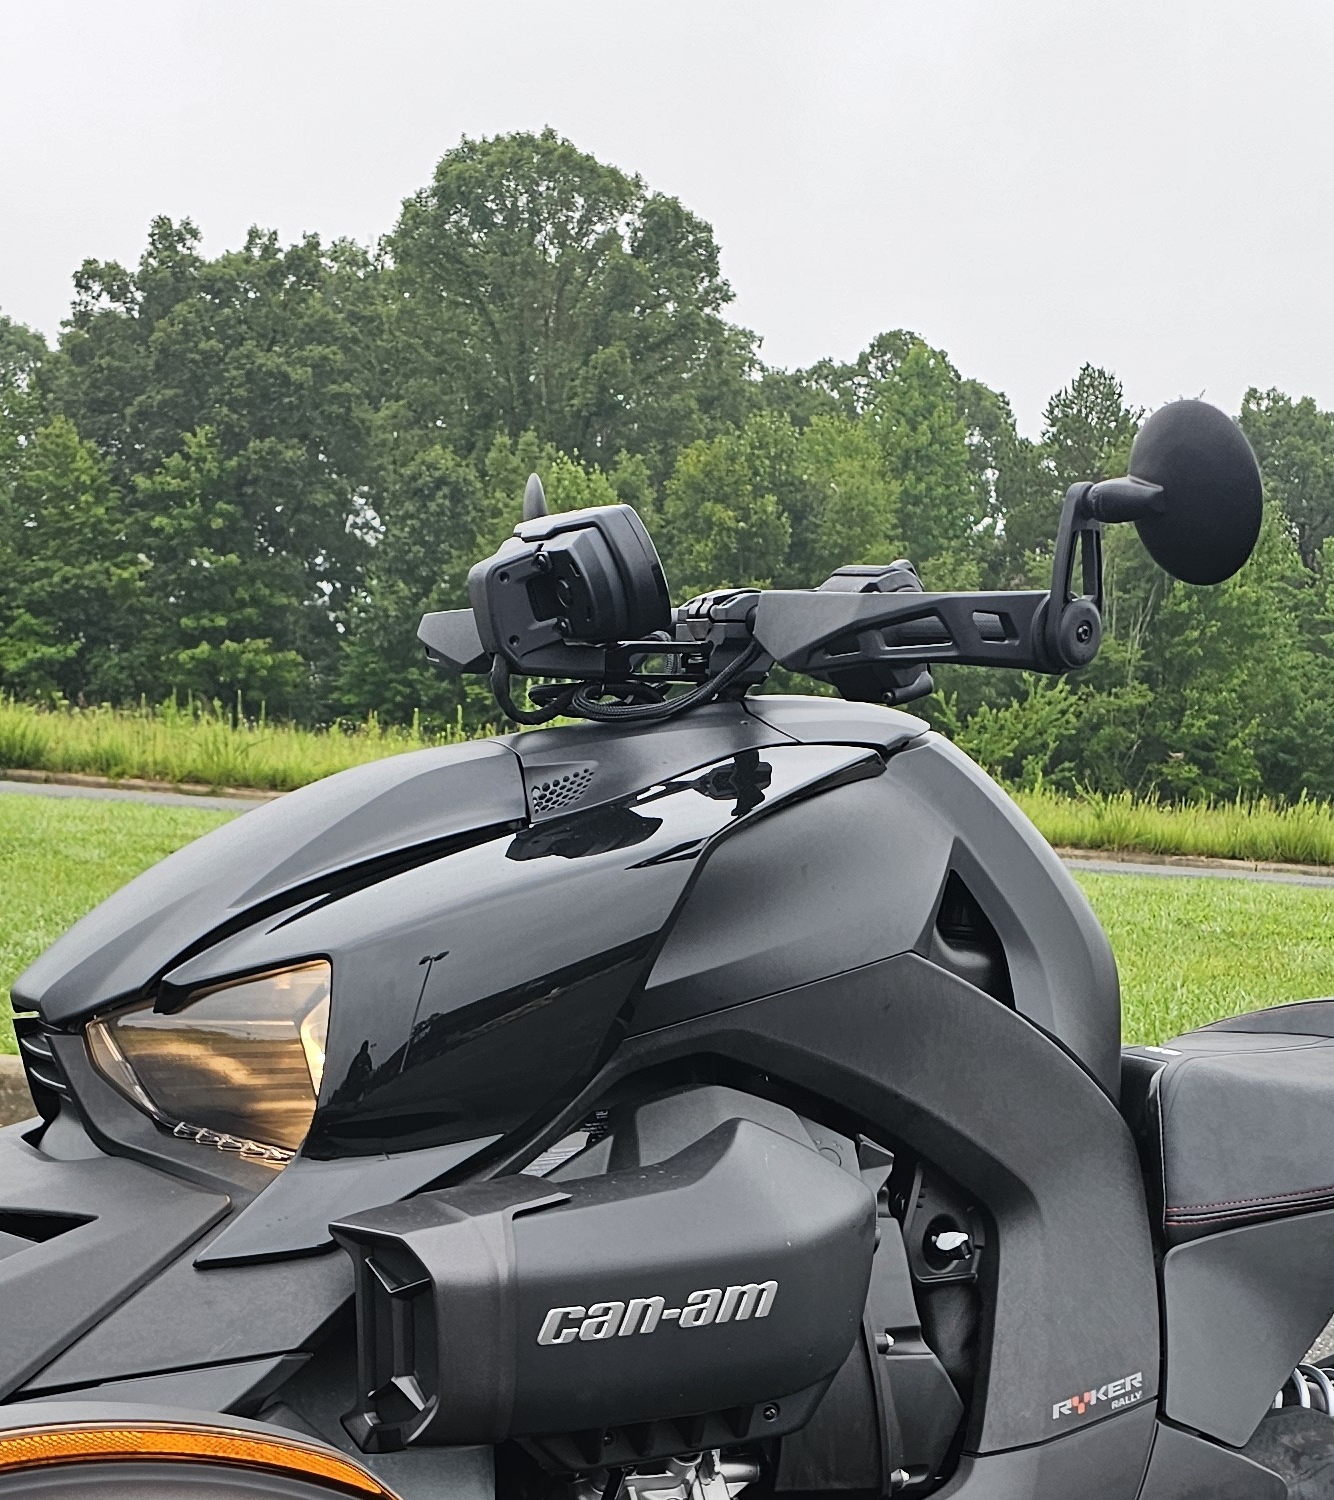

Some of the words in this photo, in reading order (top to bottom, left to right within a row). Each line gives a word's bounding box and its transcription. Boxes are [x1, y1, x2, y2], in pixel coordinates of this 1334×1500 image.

[536, 1280, 779, 1346] can-am
[1052, 1371, 1143, 1420] RYKER
[1110, 1390, 1143, 1410] RALLY
